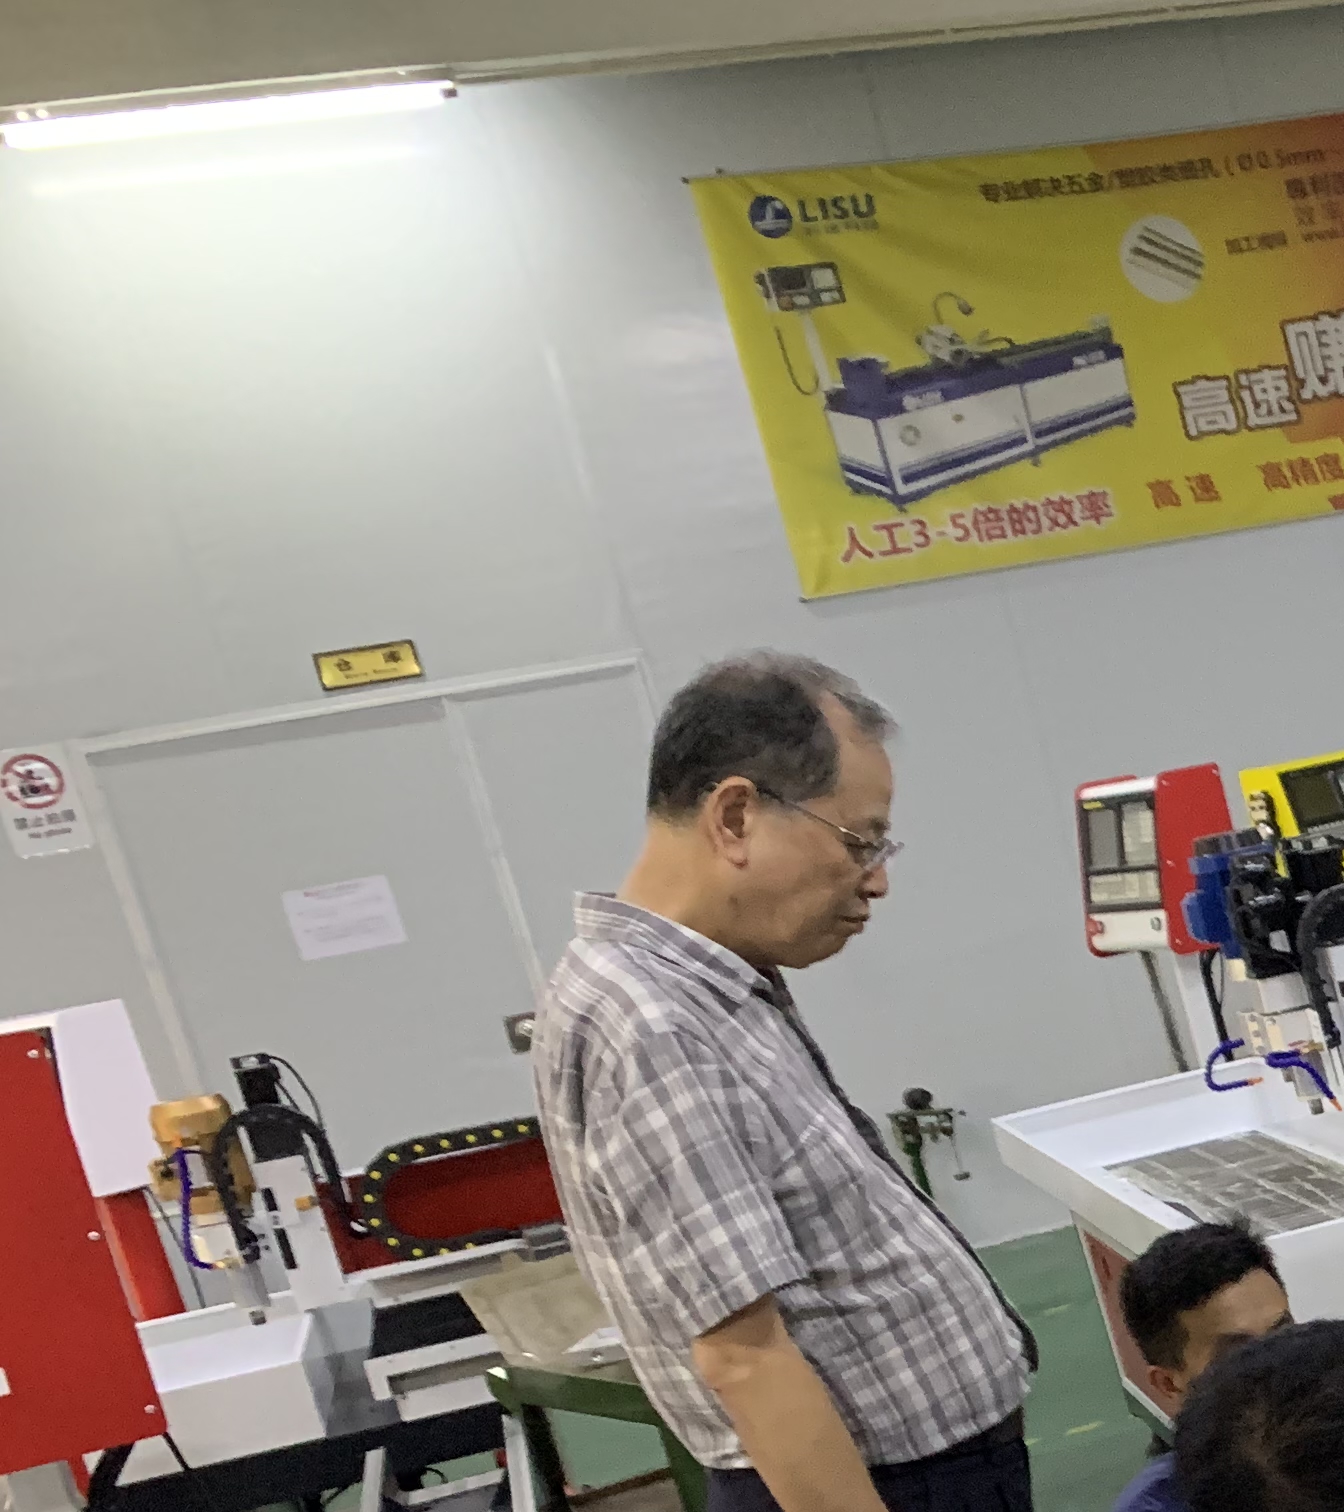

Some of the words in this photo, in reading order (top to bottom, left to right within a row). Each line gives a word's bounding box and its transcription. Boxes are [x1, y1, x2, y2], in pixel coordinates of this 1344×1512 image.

[797, 192, 877, 222] LISU
[840, 489, 1114, 563] 人工3-5倍的效率
